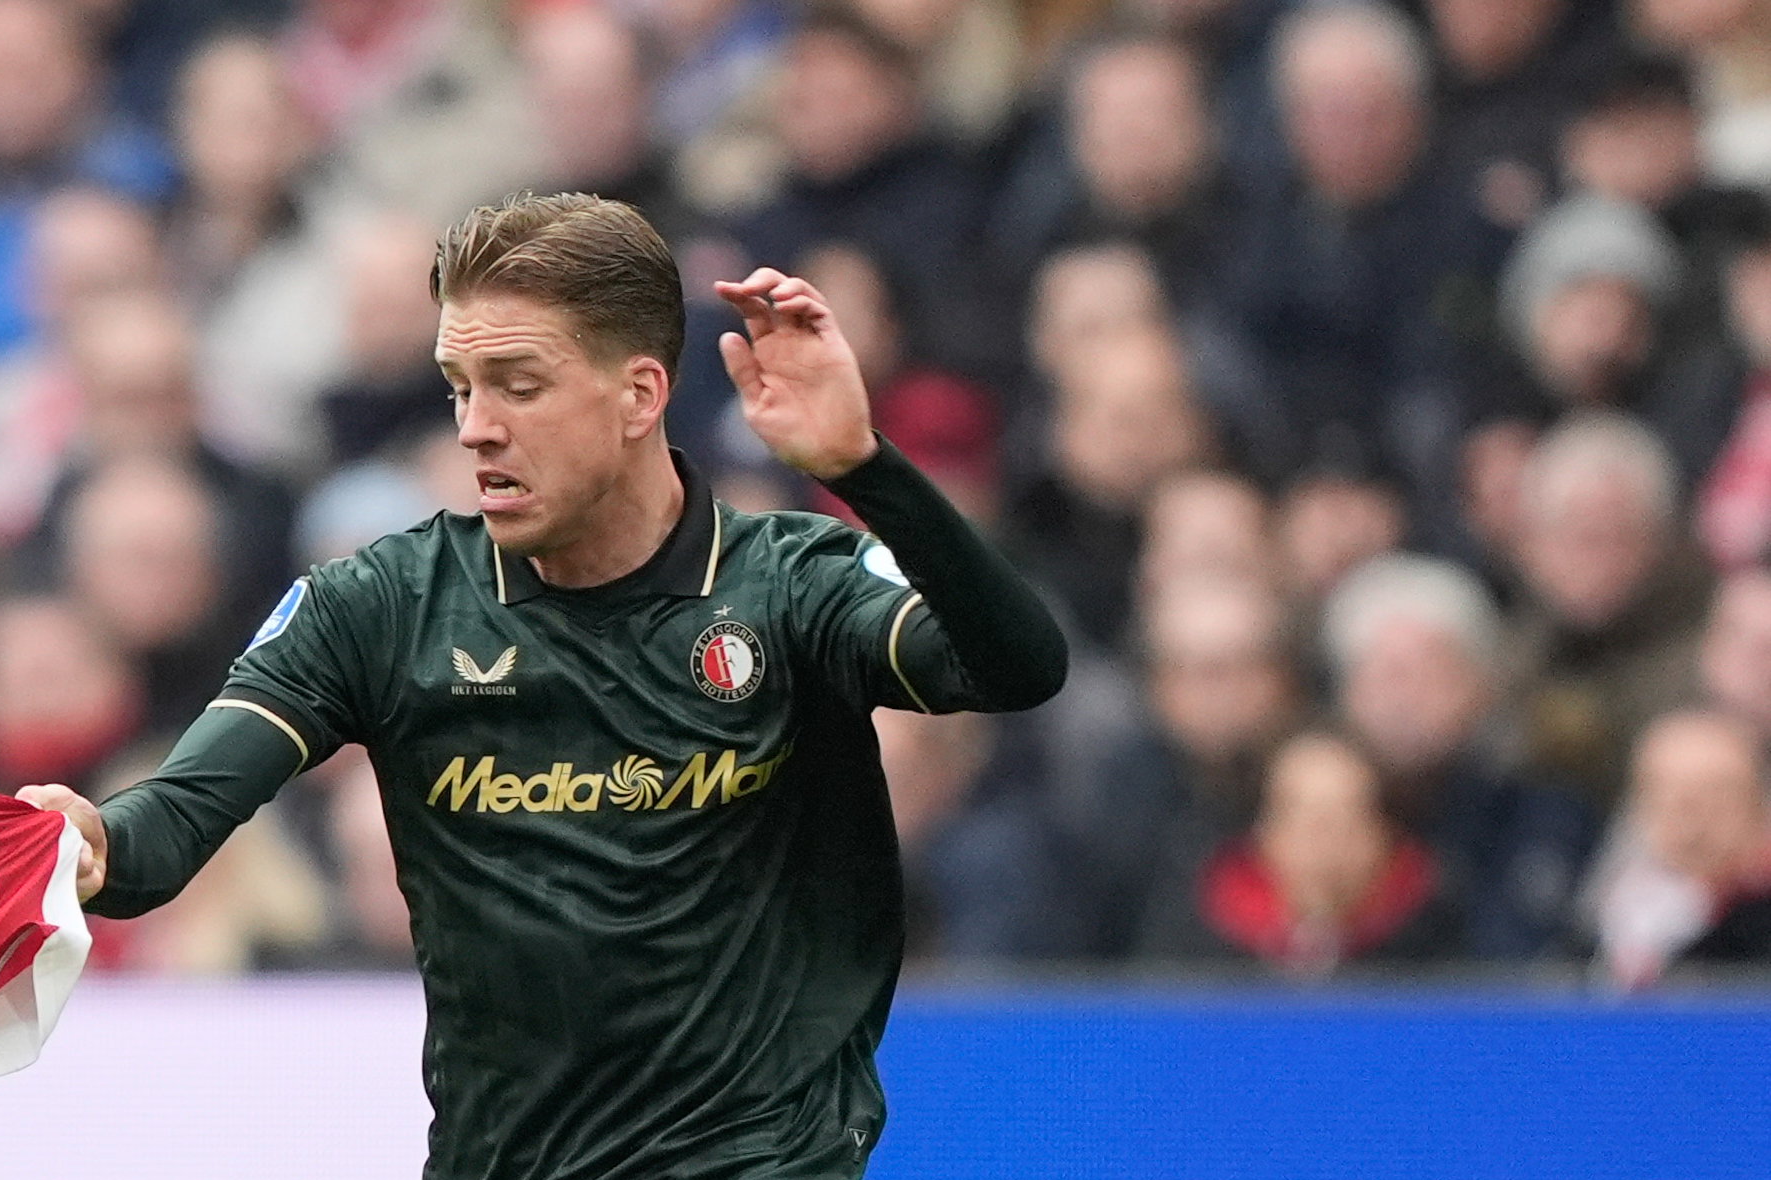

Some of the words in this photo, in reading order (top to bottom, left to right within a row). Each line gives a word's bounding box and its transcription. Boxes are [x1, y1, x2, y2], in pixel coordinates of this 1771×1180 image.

[694, 624, 755, 658] FEYENOORD
[451, 685, 471, 696] HET
[473, 685, 517, 696] LEGIOEN
[700, 666, 761, 700] ROTTERDAM
[426, 755, 606, 814] Media
[654, 738, 797, 811] Mar
